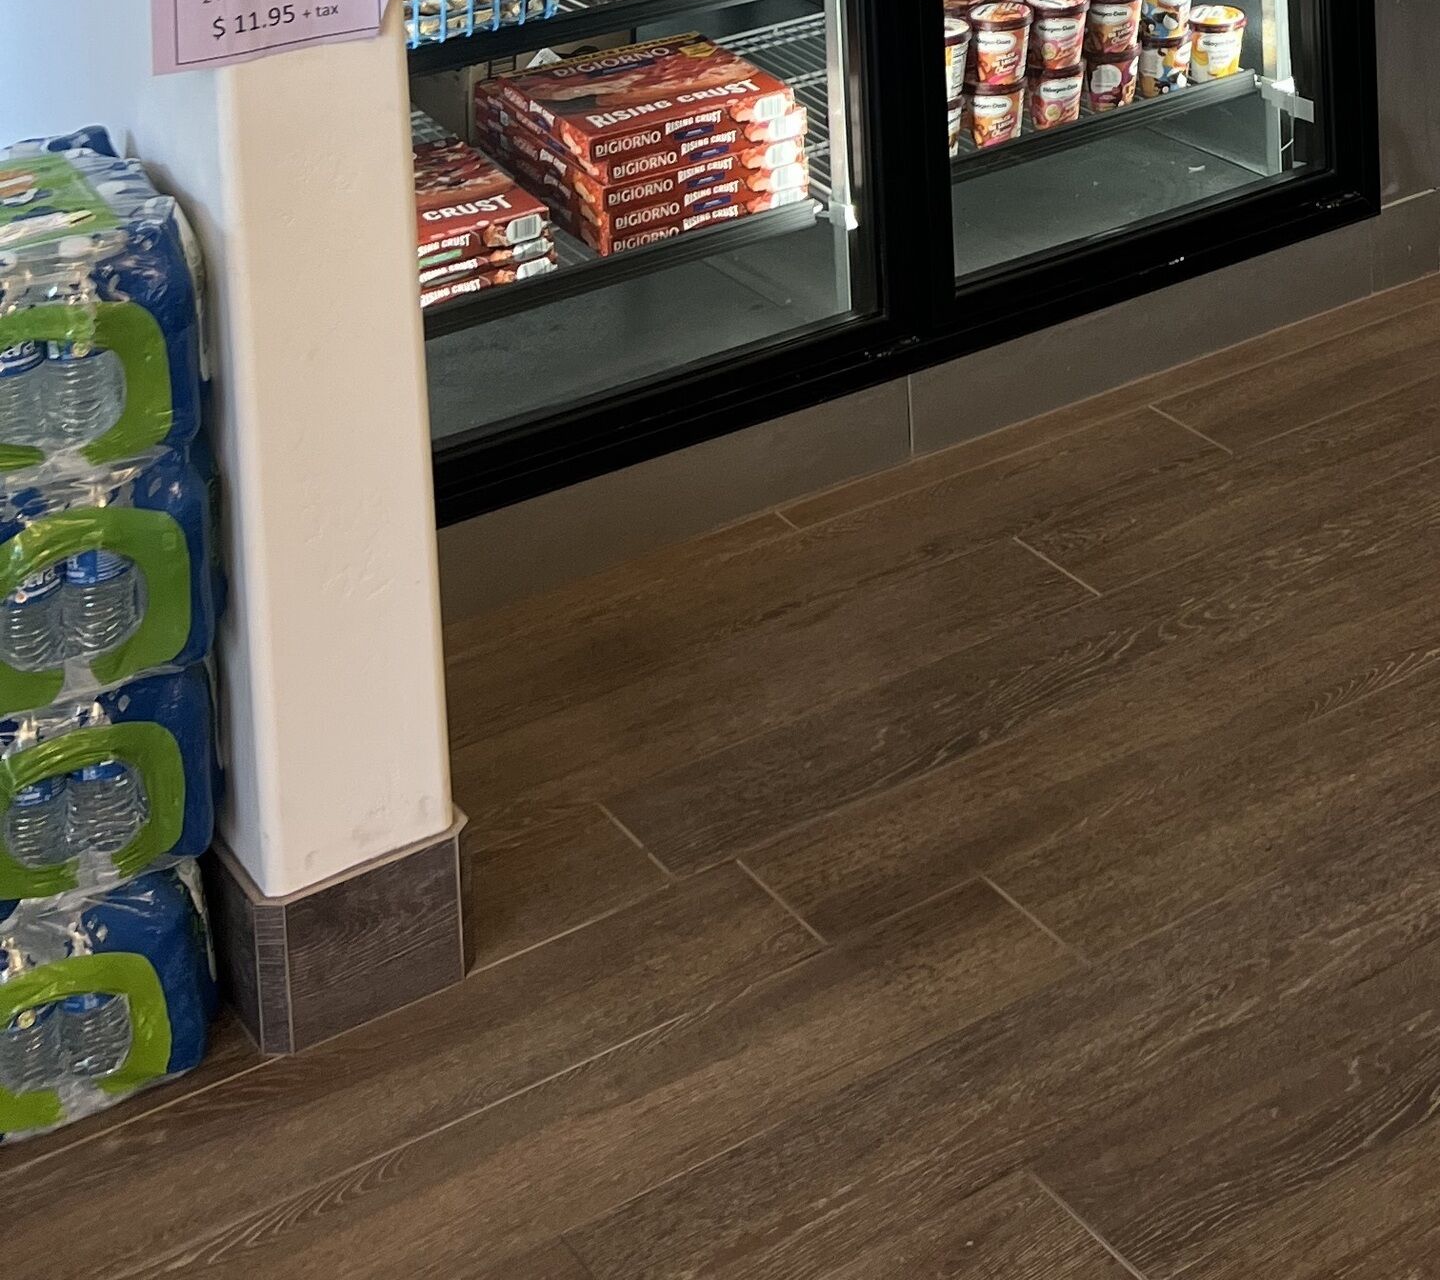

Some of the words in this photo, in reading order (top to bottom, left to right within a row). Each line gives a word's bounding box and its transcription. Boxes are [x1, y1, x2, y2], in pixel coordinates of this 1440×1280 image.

[212, 15, 226, 40] $
[234, 4, 296, 34] 11.95
[302, 10, 311, 19] +
[316, 3, 339, 18] tax
[553, 47, 670, 78] DIGIORNO
[586, 98, 671, 129] RISING
[677, 78, 761, 104] CRUST
[595, 130, 662, 158] DIGIORNO
[665, 117, 693, 135] RISING
[695, 109, 722, 124] CRUST
[613, 151, 677, 179] DIGIORNO
[681, 138, 708, 156] RISING
[710, 130, 737, 145] CRUST
[608, 178, 673, 206] DIGIORNO
[677, 165, 705, 183] RISING
[707, 157, 733, 172] CRUST
[422, 194, 512, 221] CRUST
[615, 202, 680, 230] DIGIORNO
[684, 188, 711, 207] RISING
[713, 180, 739, 195] CRUST
[683, 212, 711, 231] RISING
[712, 204, 739, 219] CRUST
[441, 233, 470, 247] CRUST
[452, 278, 481, 294] CRUST
